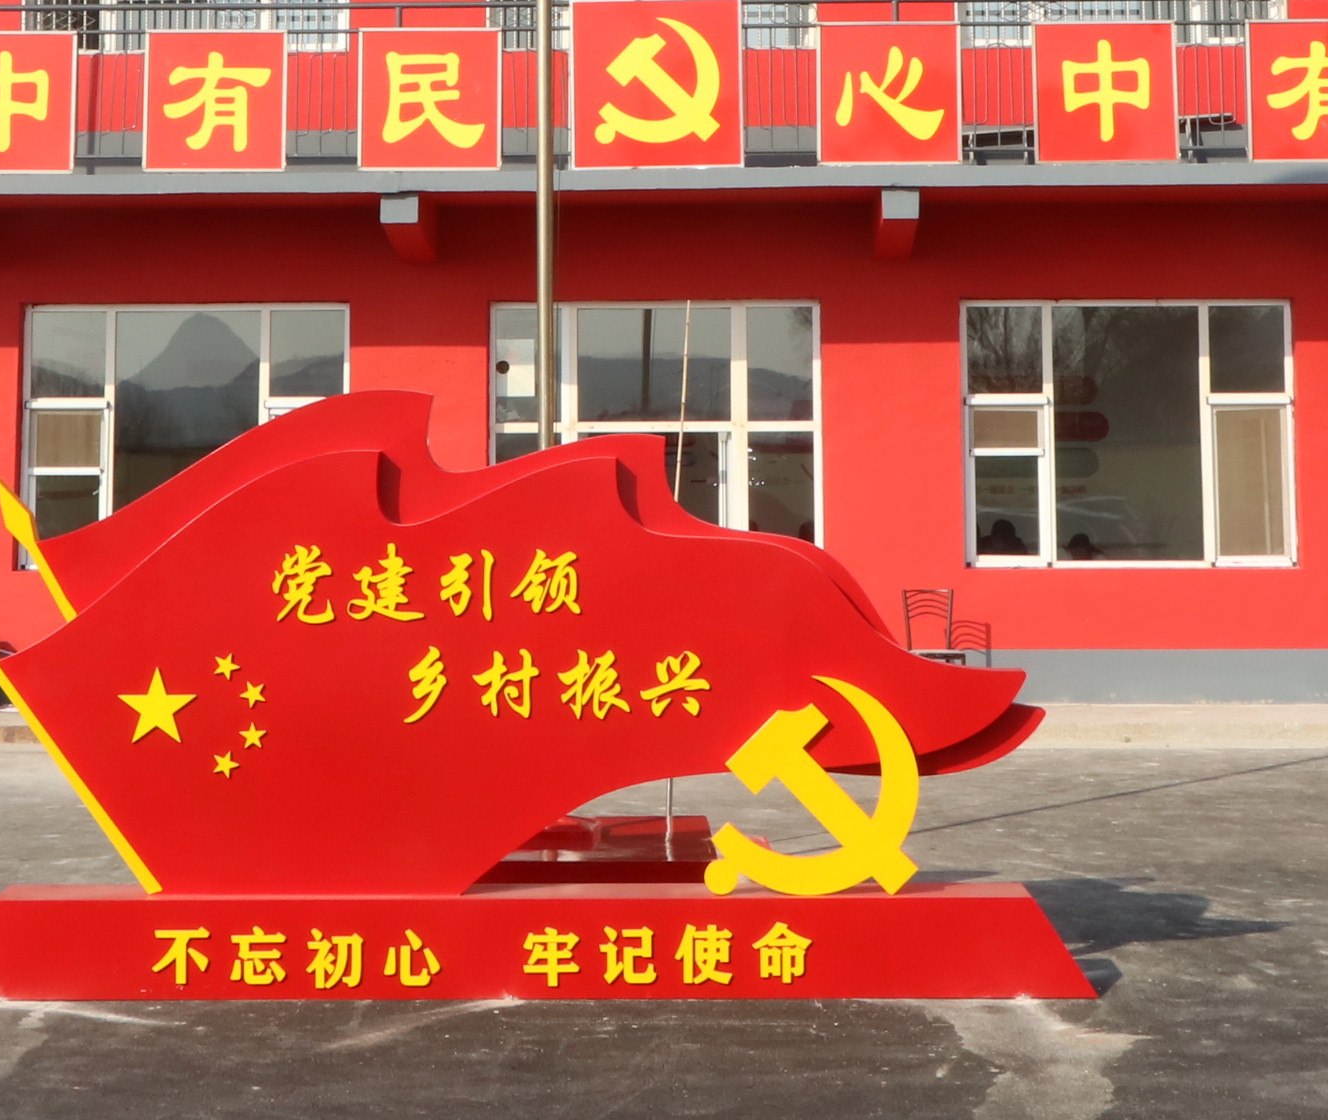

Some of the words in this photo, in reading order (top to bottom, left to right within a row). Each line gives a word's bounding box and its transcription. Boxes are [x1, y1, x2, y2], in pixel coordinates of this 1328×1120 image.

[272, 543, 581, 624] 党建引领
[404, 645, 711, 724] 乡村振兴
[152, 926, 441, 989] 不忘初心
[522, 921, 812, 987] 牢记使命
